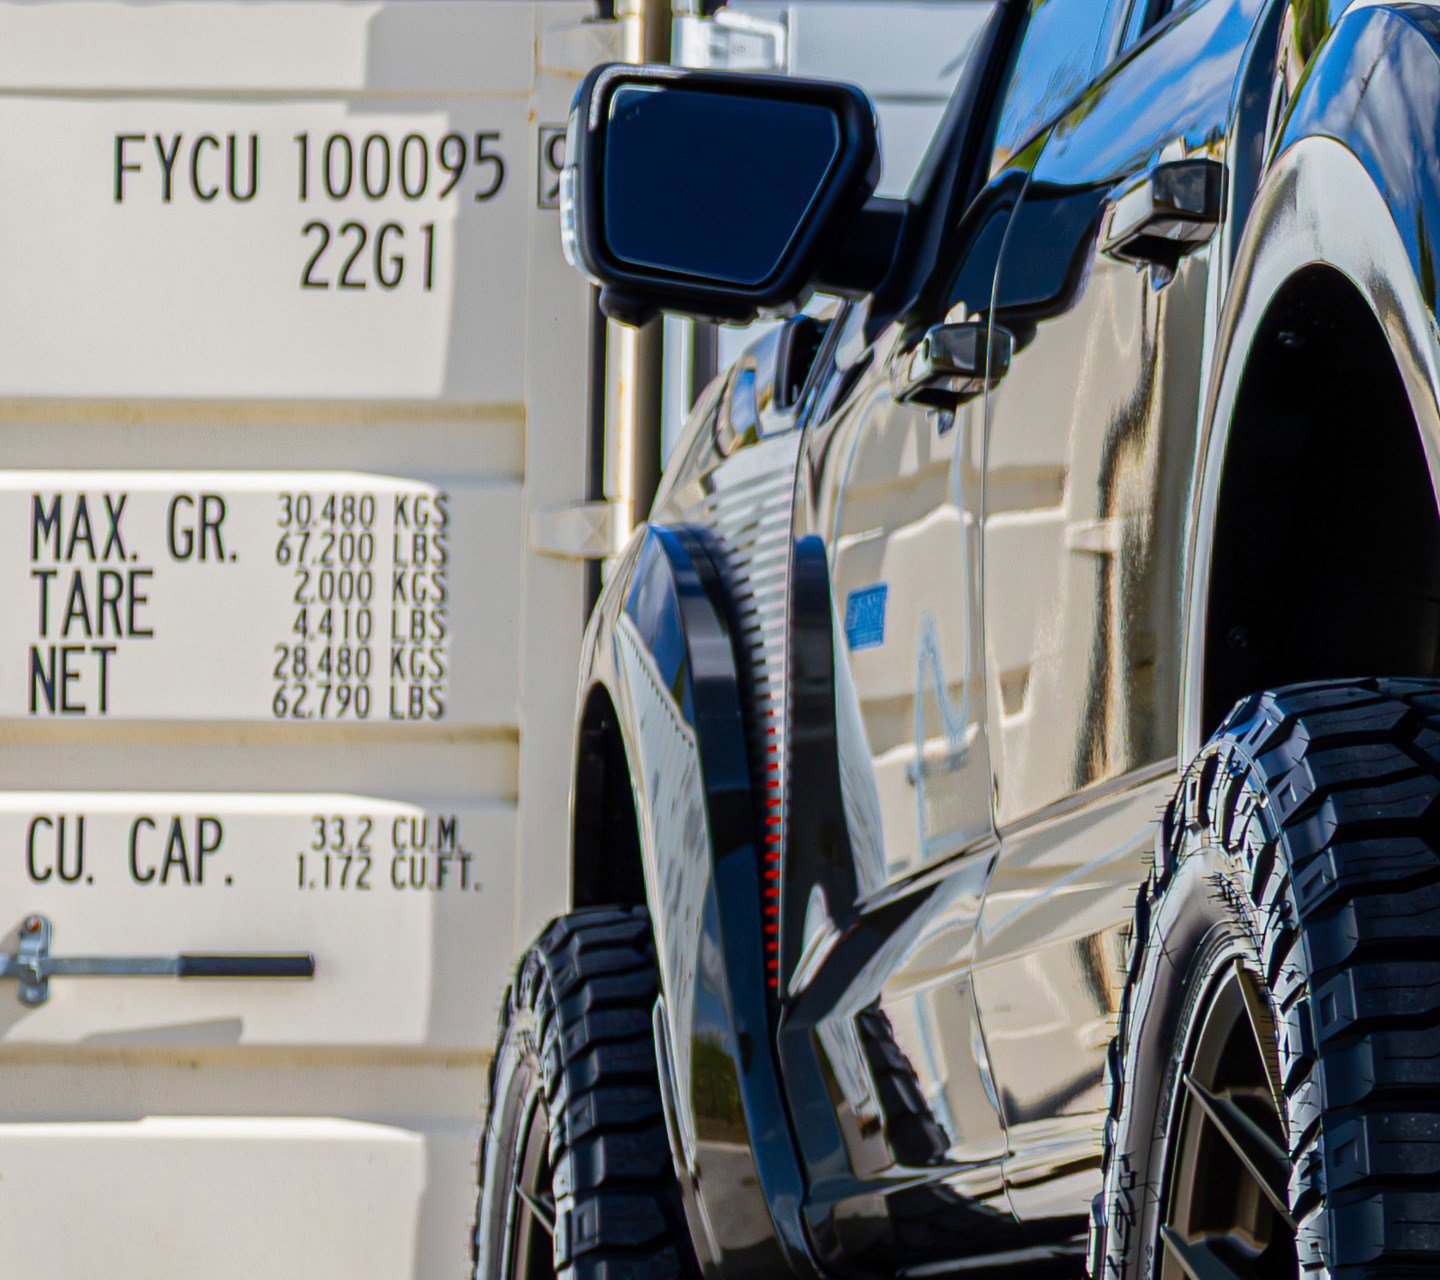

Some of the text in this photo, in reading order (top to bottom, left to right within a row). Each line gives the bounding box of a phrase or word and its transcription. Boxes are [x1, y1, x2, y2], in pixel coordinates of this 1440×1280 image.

[114, 132, 259, 204] FYCU
[294, 131, 507, 202] 100095
[300, 220, 436, 291] 22G1
[31, 492, 450, 562] MAX. GR. 30.480 KGS
[275, 530, 449, 567] 67.200 LBS
[31, 568, 448, 638] TARE 2.000 KGS
[292, 607, 447, 643] 4.410 LBS
[29, 644, 446, 715] NET 28.480 KGS
[272, 682, 445, 719] 62.790 LBS
[26, 814, 95, 885] CU.
[128, 814, 234, 886] CAP.
[311, 815, 374, 851] 33.2
[298, 852, 372, 890] 1.172
